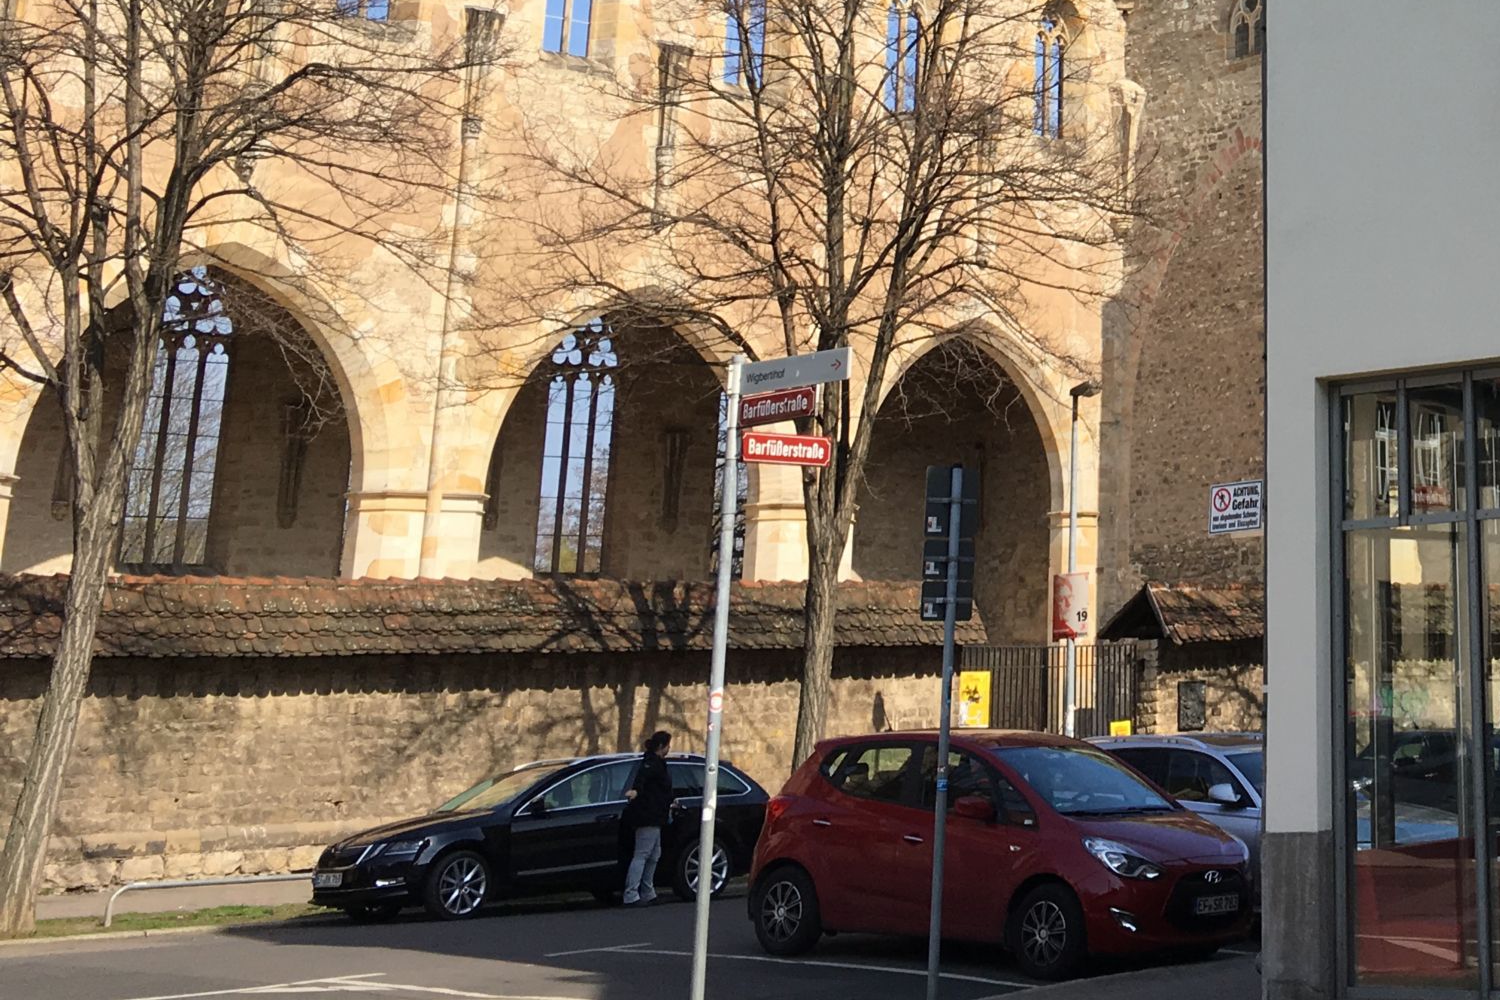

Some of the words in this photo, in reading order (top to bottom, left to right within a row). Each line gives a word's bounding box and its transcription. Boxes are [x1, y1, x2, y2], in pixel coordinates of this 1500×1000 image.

[743, 394, 808, 419] Barfüßerstraße
[748, 438, 825, 460] Barfüßerstraße
[1232, 498, 1259, 510] Gefahr
[1076, 610, 1088, 622] 19
